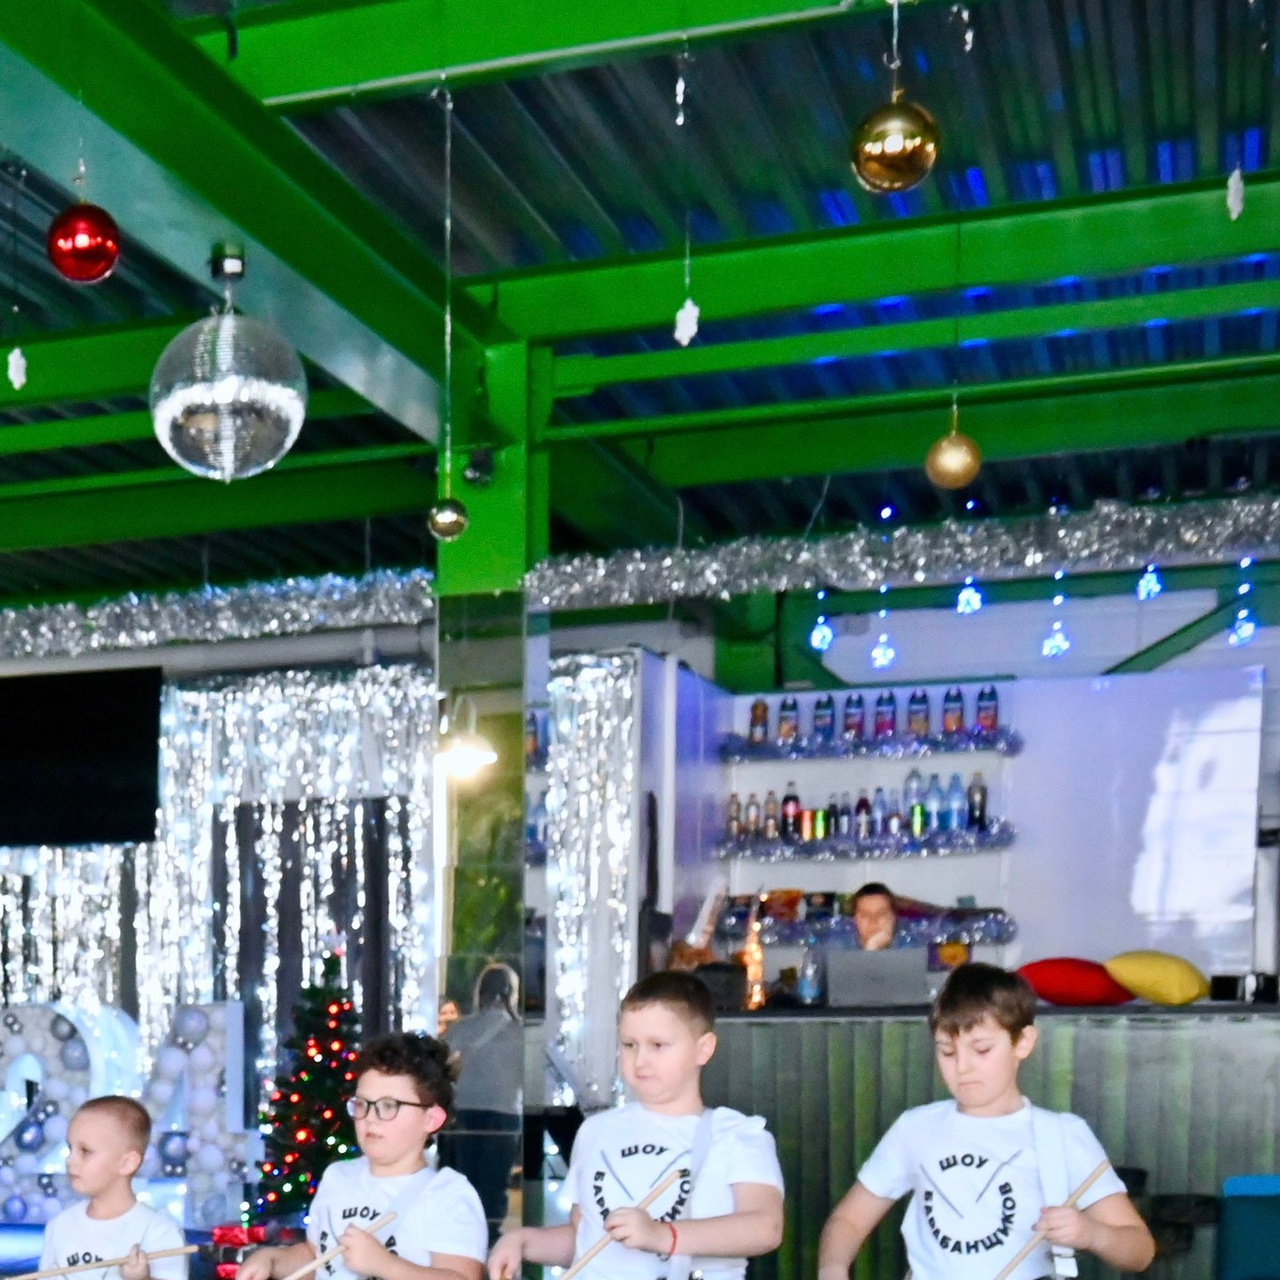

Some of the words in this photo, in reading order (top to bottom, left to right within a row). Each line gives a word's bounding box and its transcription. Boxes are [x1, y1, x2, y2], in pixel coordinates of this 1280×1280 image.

[621, 1143, 670, 1159] ШОУ
[939, 1153, 990, 1172] ШОУ
[341, 1205, 381, 1221] ШОУ
[924, 1181, 1017, 1255] БАРАБАНЩИКОВ
